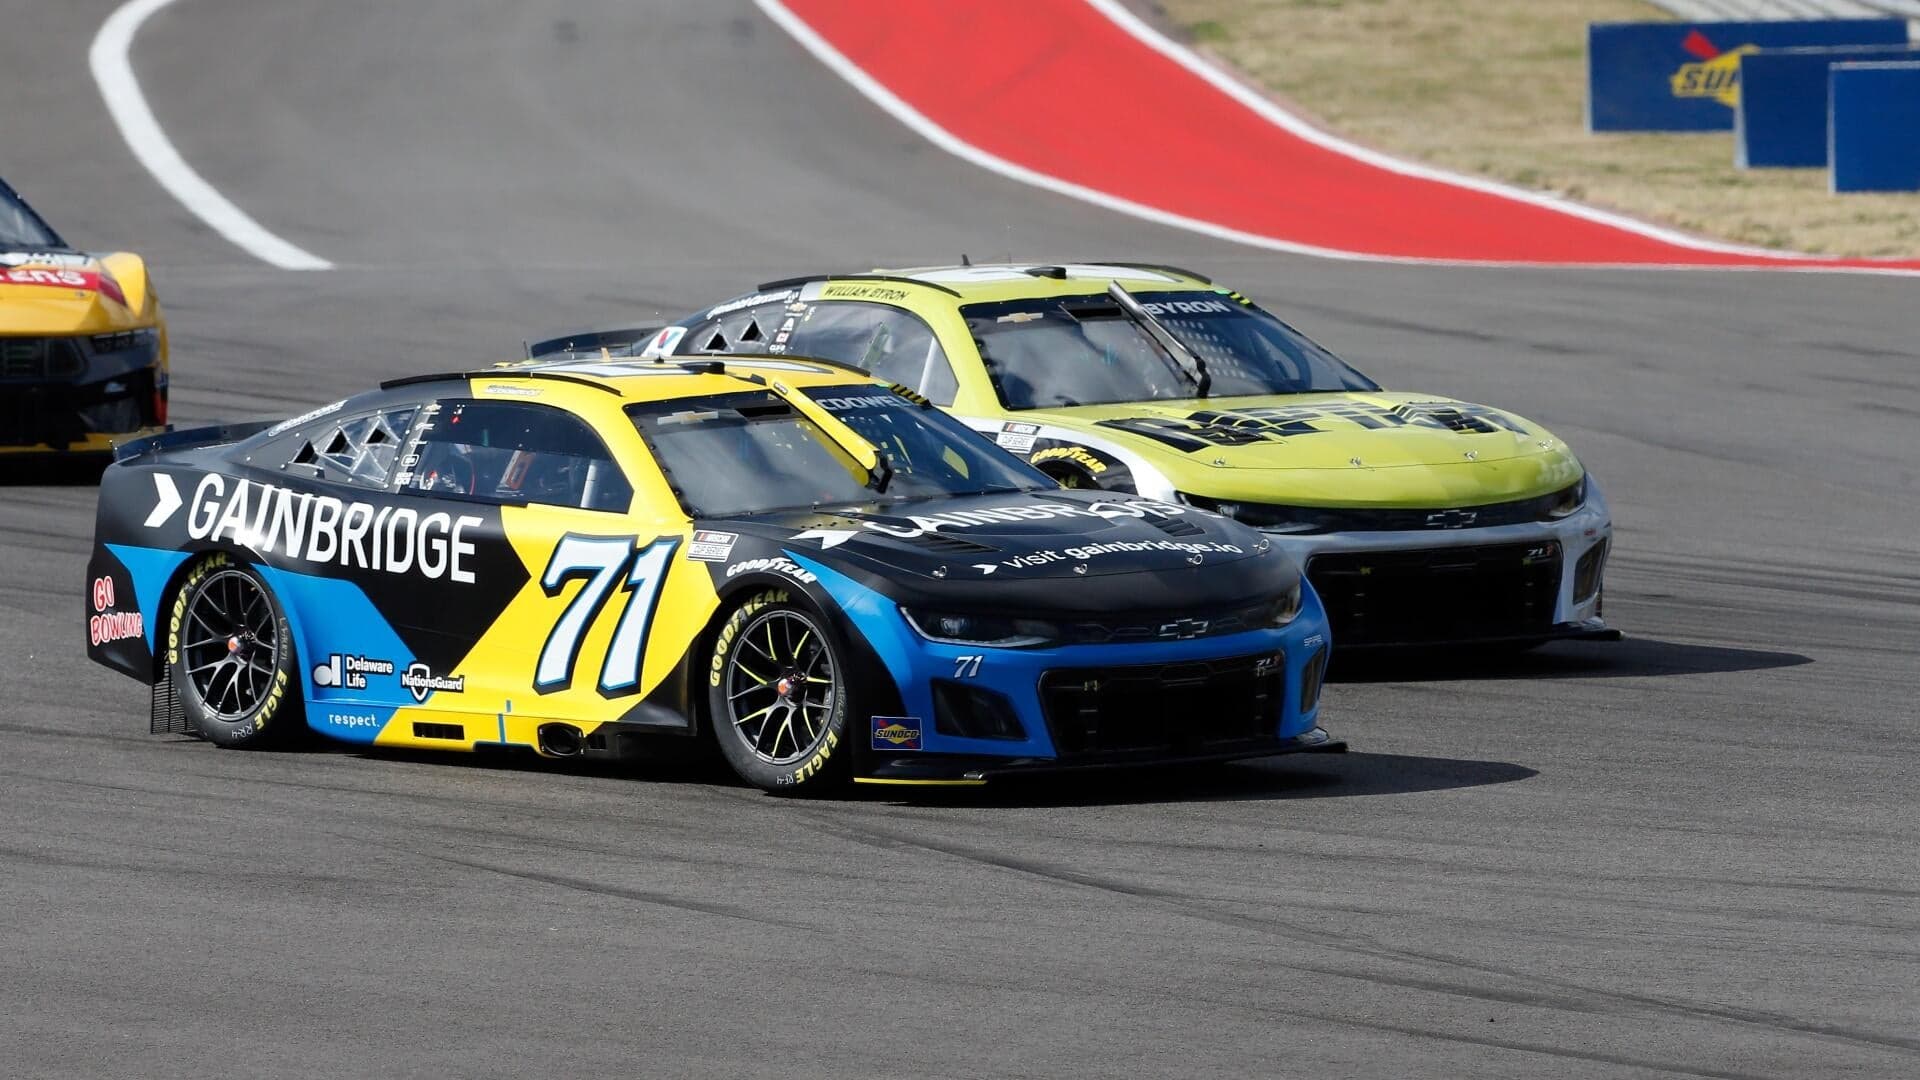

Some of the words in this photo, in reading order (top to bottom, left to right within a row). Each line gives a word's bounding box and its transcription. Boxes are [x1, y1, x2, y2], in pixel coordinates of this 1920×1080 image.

[824, 287, 867, 298] WILLIAM
[869, 288, 910, 301] BYRON
[1143, 301, 1232, 315] BYRON
[1030, 446, 1107, 473] GOODYEAR
[187, 472, 484, 584] GAINBRIDGE
[1003, 549, 1067, 569] visit
[1063, 539, 1244, 561] gainbridge.io
[726, 557, 818, 584] GOODYEAR
[93, 575, 115, 612] GO
[90, 612, 143, 646] BOWLING
[532, 531, 684, 700] 71
[710, 589, 789, 687] GOODYEAR
[346, 655, 394, 674] Delaware
[953, 655, 984, 679] 71
[346, 673, 367, 688] Life
[401, 673, 464, 691] NationsGuard
[254, 668, 288, 730] EAGLE
[328, 713, 381, 728] respect.
[876, 729, 918, 739] SUNOCO
[795, 727, 839, 784] EAGLE
